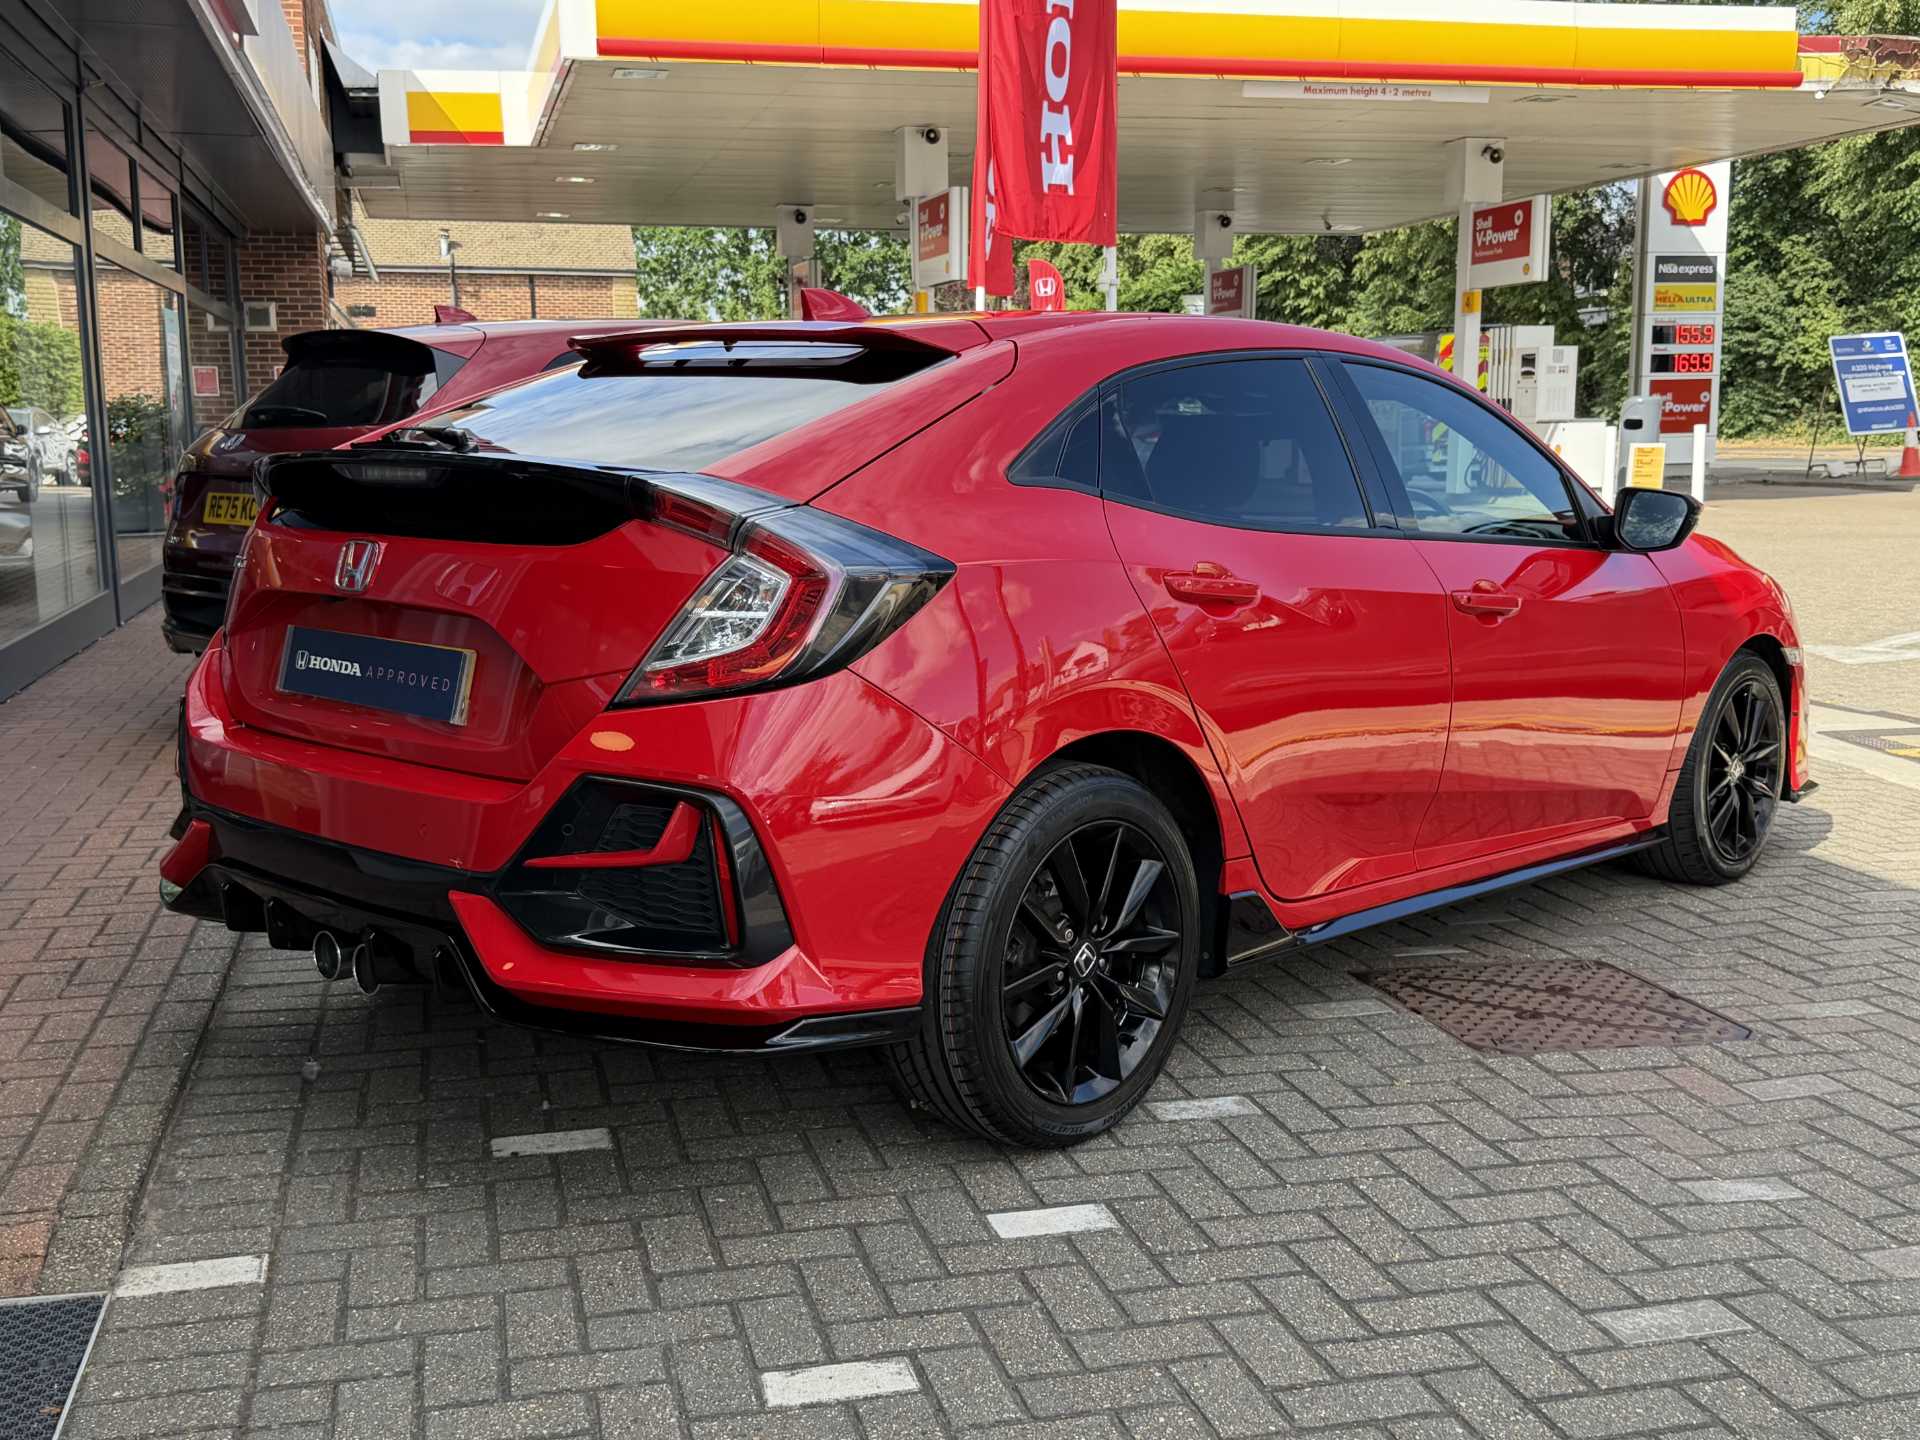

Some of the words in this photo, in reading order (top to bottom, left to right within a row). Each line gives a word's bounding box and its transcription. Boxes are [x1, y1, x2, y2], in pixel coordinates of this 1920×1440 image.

[1040, 0, 1075, 196] HO
[1303, 85, 1348, 96] Maximum
[1350, 85, 1378, 97] height
[1401, 88, 1432, 97] metres
[1476, 216, 1493, 231] Shell
[1476, 228, 1520, 247] V-Power
[1679, 265, 1714, 275] express
[1675, 324, 1714, 344] 155.9
[1674, 353, 1713, 373] 169.9
[1661, 401, 1706, 412] -Power
[208, 495, 239, 518] RE75
[308, 655, 362, 677] HONDA
[366, 665, 450, 692] APPROVED
